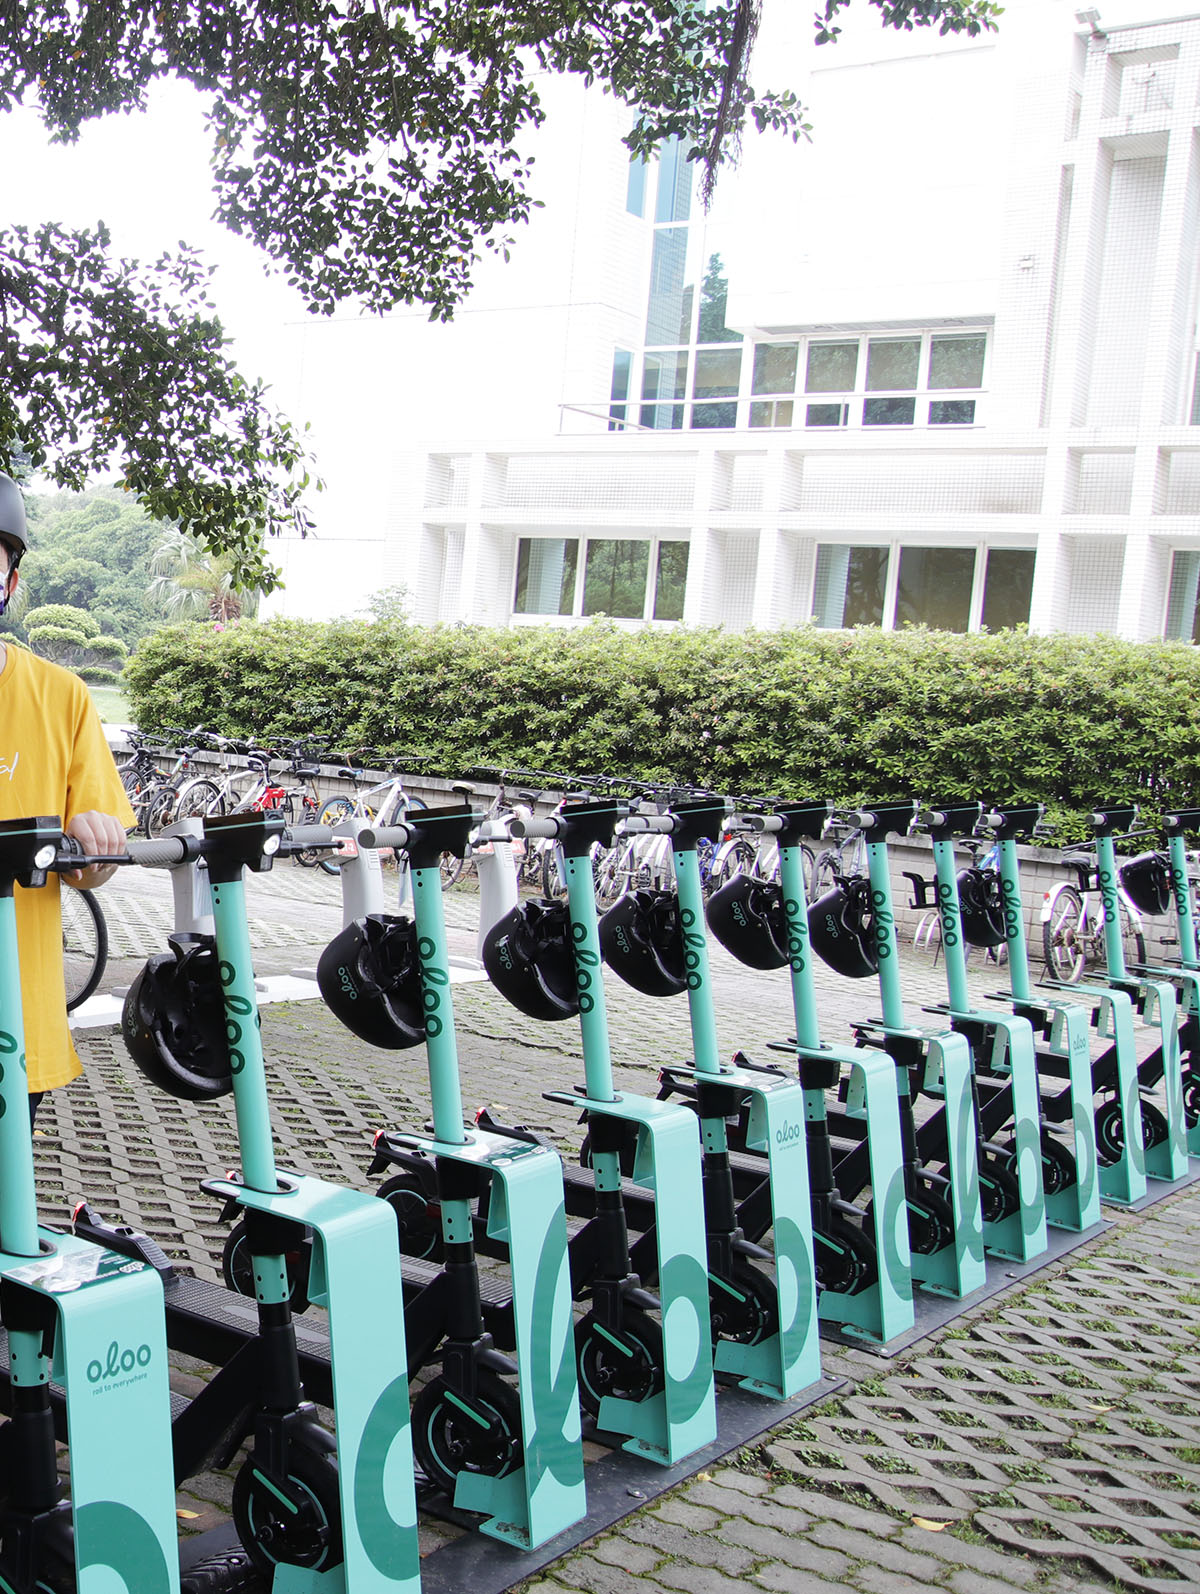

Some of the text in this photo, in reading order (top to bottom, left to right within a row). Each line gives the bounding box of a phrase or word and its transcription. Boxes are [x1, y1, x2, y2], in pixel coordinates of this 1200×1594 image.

[731, 901, 747, 927] oloo
[872, 890, 893, 959] oloo
[939, 883, 959, 947] oloo
[1002, 879, 1021, 938] oloo
[1099, 871, 1117, 923] oloo
[615, 925, 630, 953] oloo
[681, 908, 706, 990] oloo
[785, 899, 807, 973] oloo
[825, 914, 839, 938] oloo
[338, 967, 358, 1000] oloo
[419, 936, 449, 1038] oloo
[572, 922, 599, 1014] oloo
[220, 960, 253, 1075] oloo
[776, 1120, 800, 1144] oloo
[87, 1341, 151, 1383] oloo
[104, 1383, 112, 1392] to
[112, 1372, 147, 1388] everywhere
